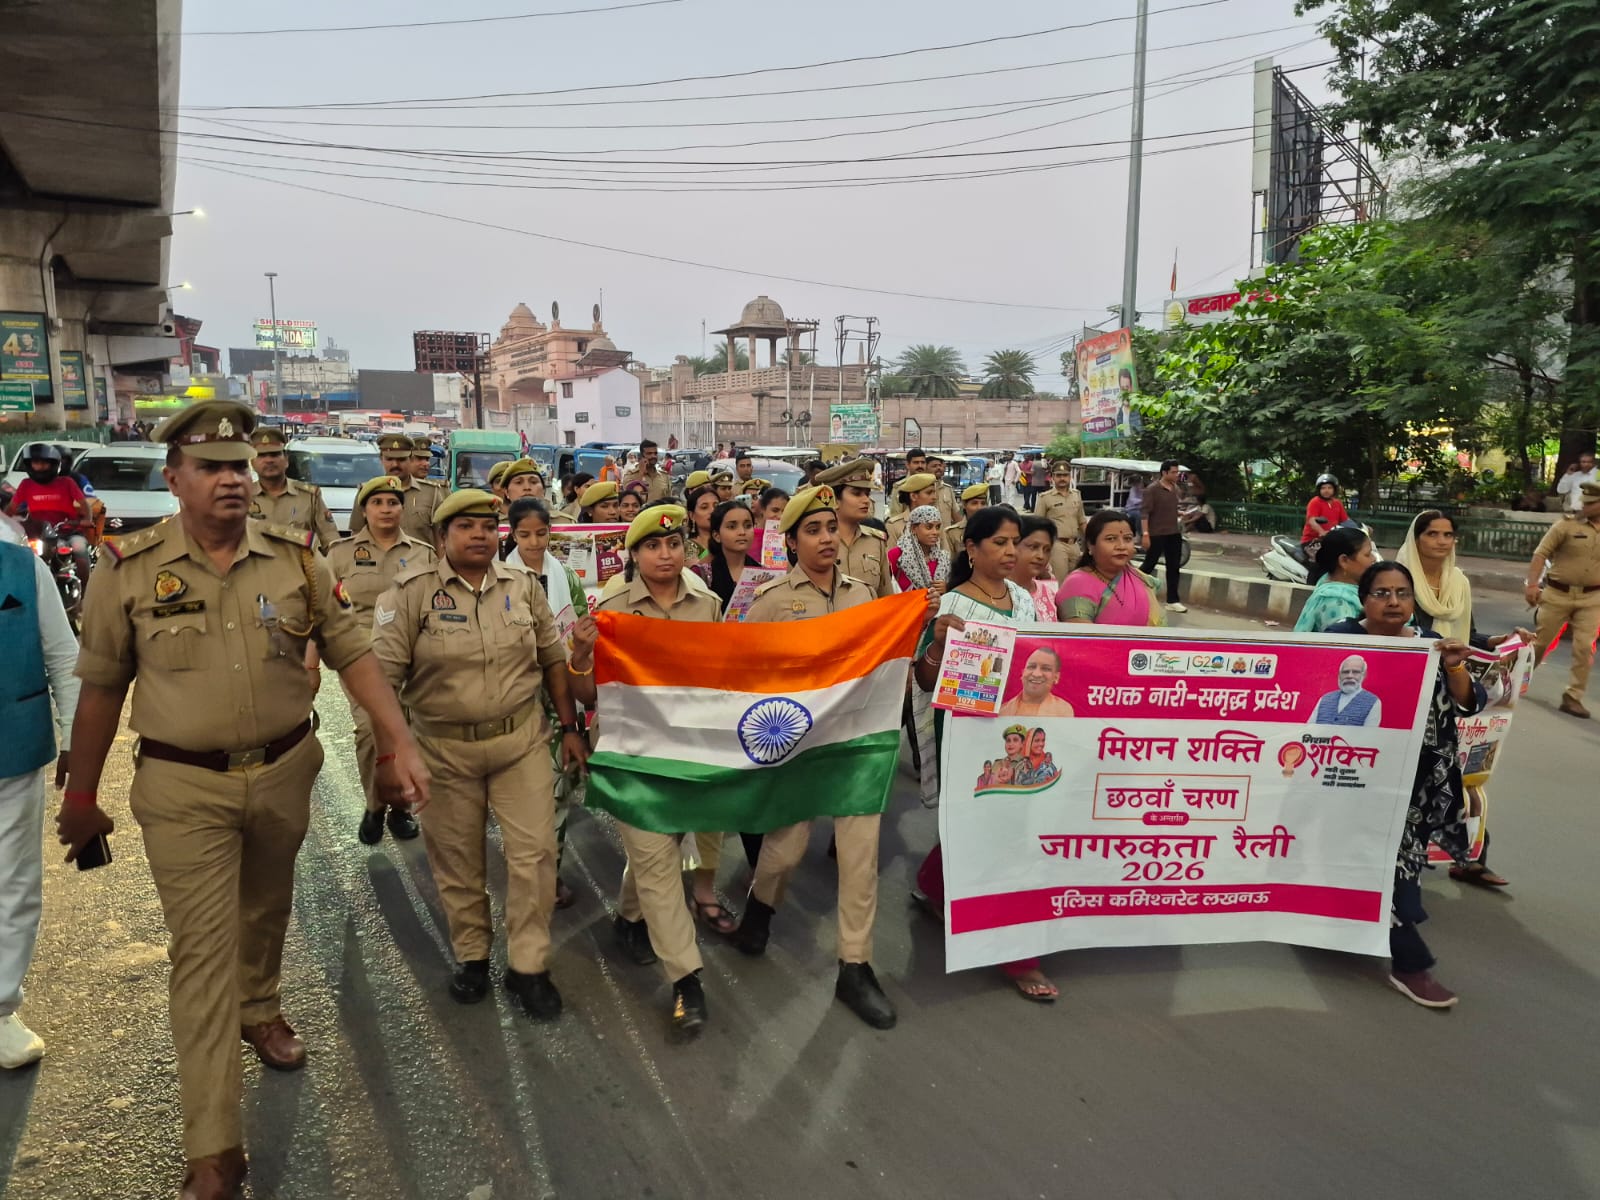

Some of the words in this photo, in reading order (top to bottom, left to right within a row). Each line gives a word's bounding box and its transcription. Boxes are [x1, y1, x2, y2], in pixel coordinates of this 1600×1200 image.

[1087, 685, 1145, 706] सशक्त
[1252, 683, 1301, 712] प्रदेश
[1097, 727, 1179, 761] मिशन
[1187, 730, 1266, 763] शक्ति
[1307, 735, 1380, 778] शक्ति
[1105, 779, 1174, 809] छठवाँ
[1182, 788, 1240, 810] चरण
[1038, 834, 1218, 860] जागरुकता
[1232, 825, 1297, 859] रैली
[1121, 861, 1206, 882] 2026
[1050, 889, 1104, 917] पुलिस
[1202, 890, 1272, 907] लखनऊ
